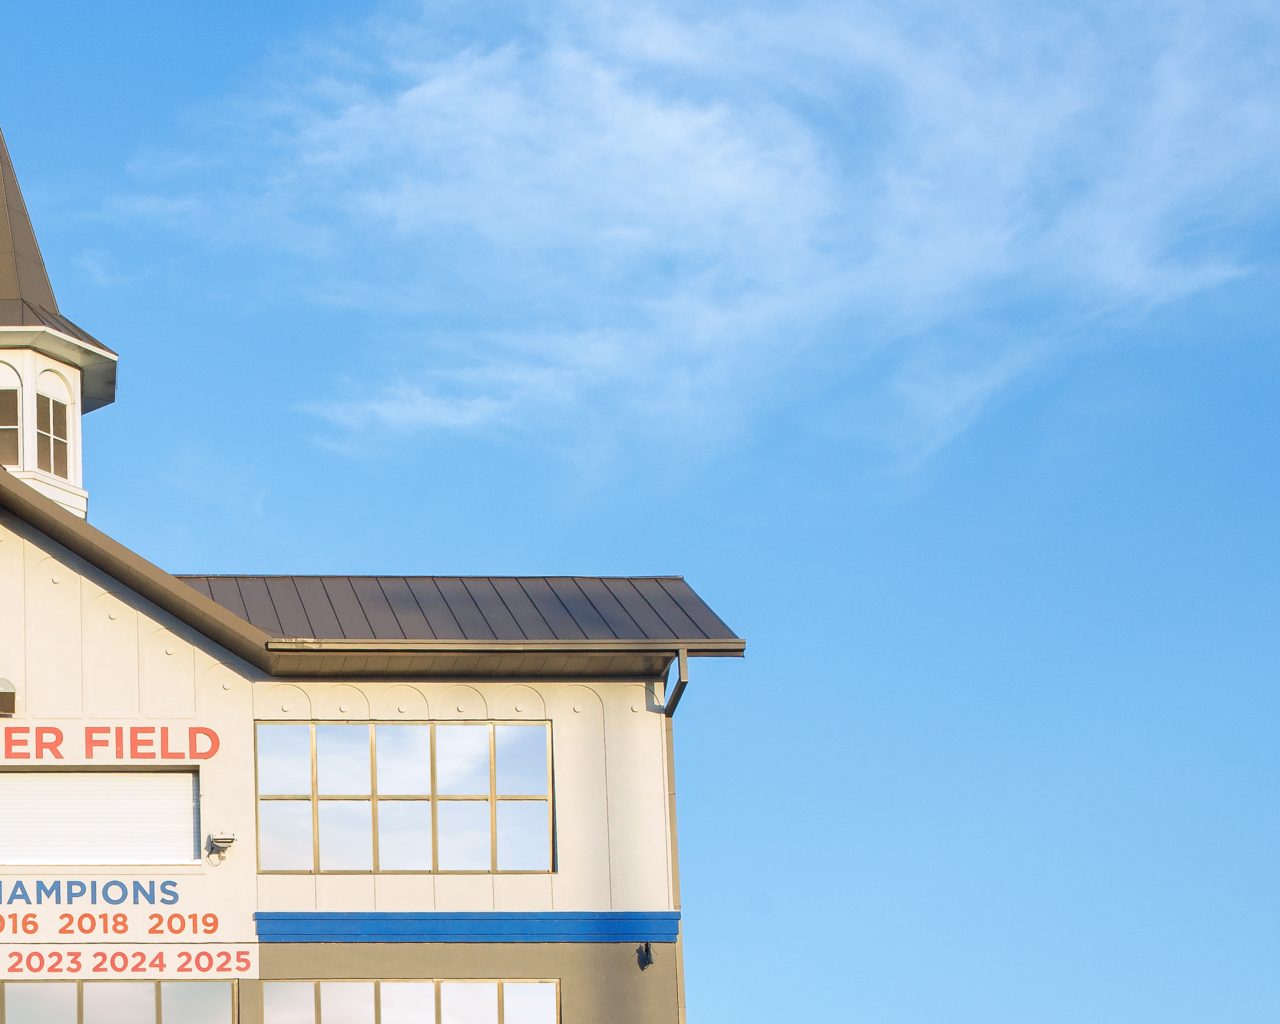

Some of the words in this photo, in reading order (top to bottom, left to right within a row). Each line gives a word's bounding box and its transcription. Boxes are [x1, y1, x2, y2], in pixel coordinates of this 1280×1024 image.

[85, 727, 220, 759] FIELD
[59, 913, 128, 934] 2018
[148, 913, 218, 934] 2019
[8, 952, 81, 973] 2023
[93, 952, 165, 972] 2024
[177, 951, 250, 972] 2025
